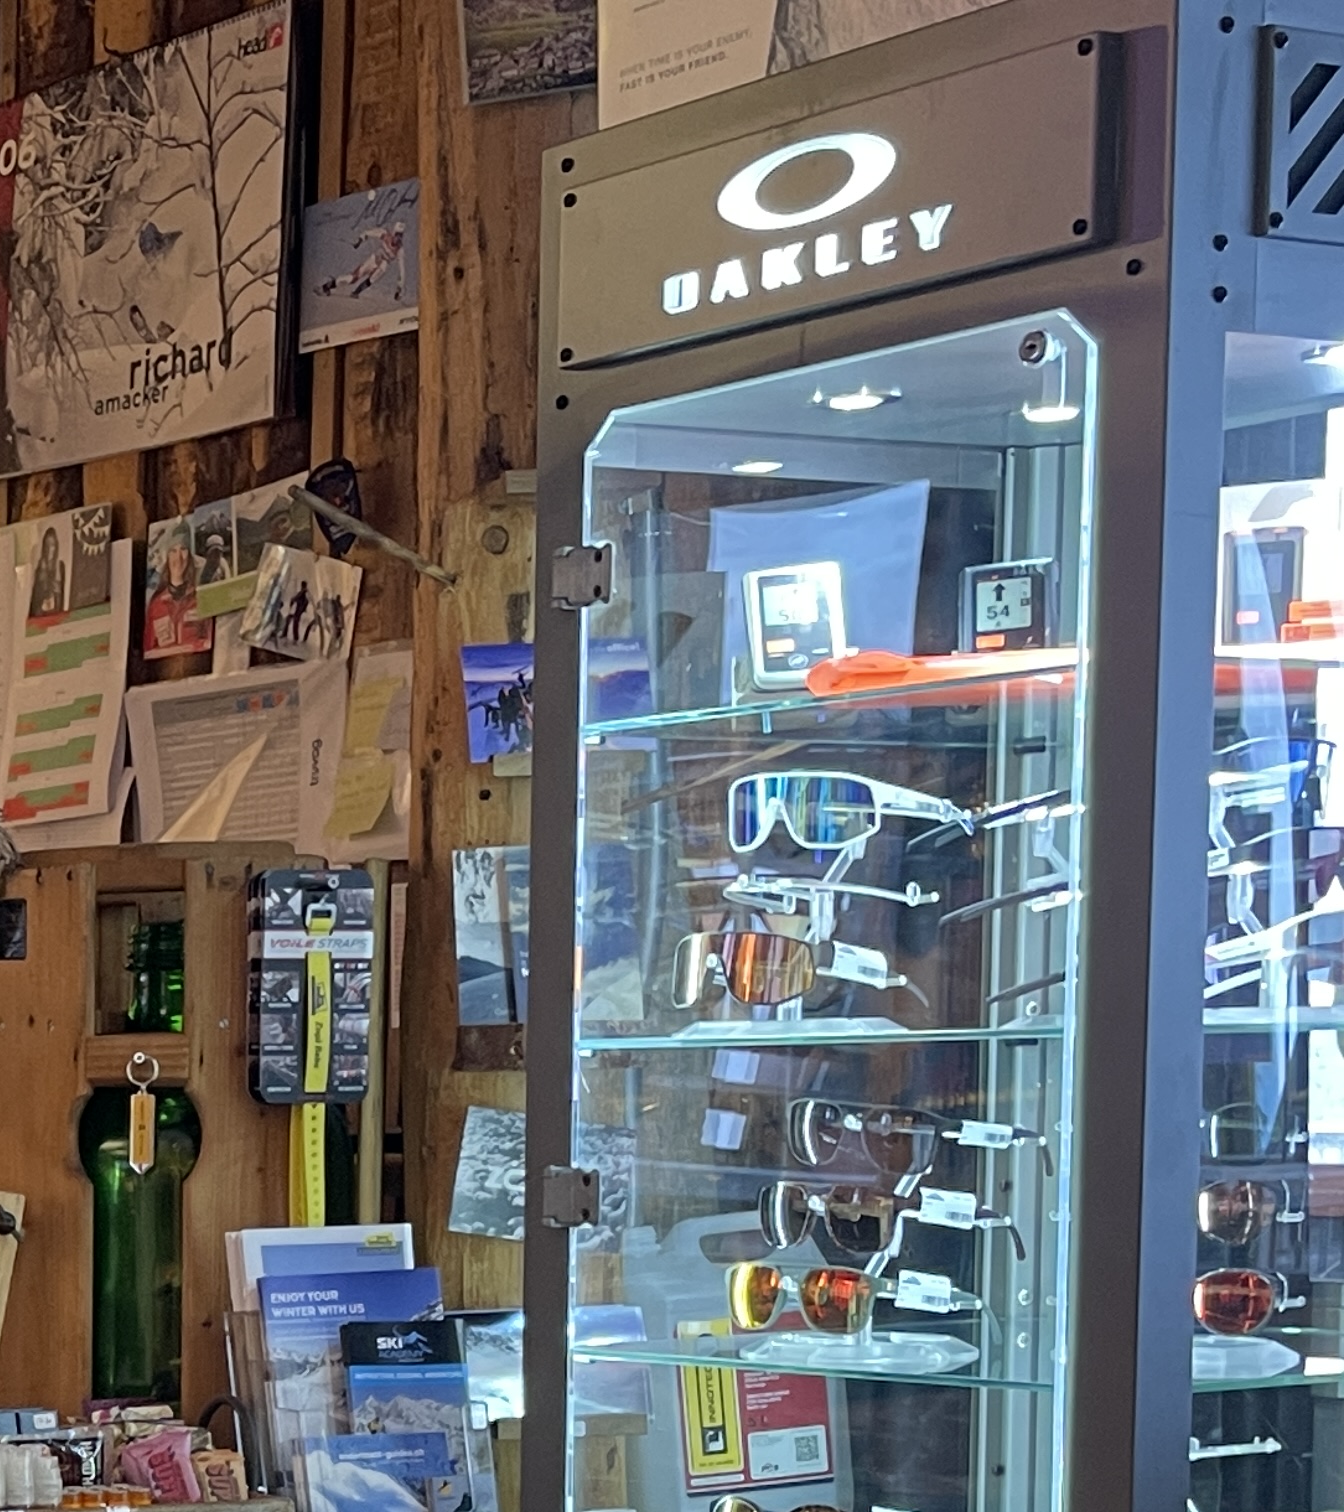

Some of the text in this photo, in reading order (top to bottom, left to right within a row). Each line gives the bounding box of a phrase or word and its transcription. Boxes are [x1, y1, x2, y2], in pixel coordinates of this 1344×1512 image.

[619, 76, 643, 93] FAST
[662, 203, 953, 315] OAKLEY
[127, 325, 233, 391] richard
[986, 604, 1011, 621] 54
[317, 936, 369, 949] STRAPS
[270, 1289, 339, 1304] ENJOY YOUR
[271, 1303, 365, 1318] WINTER WITH US
[376, 1336, 404, 1350] SKI
